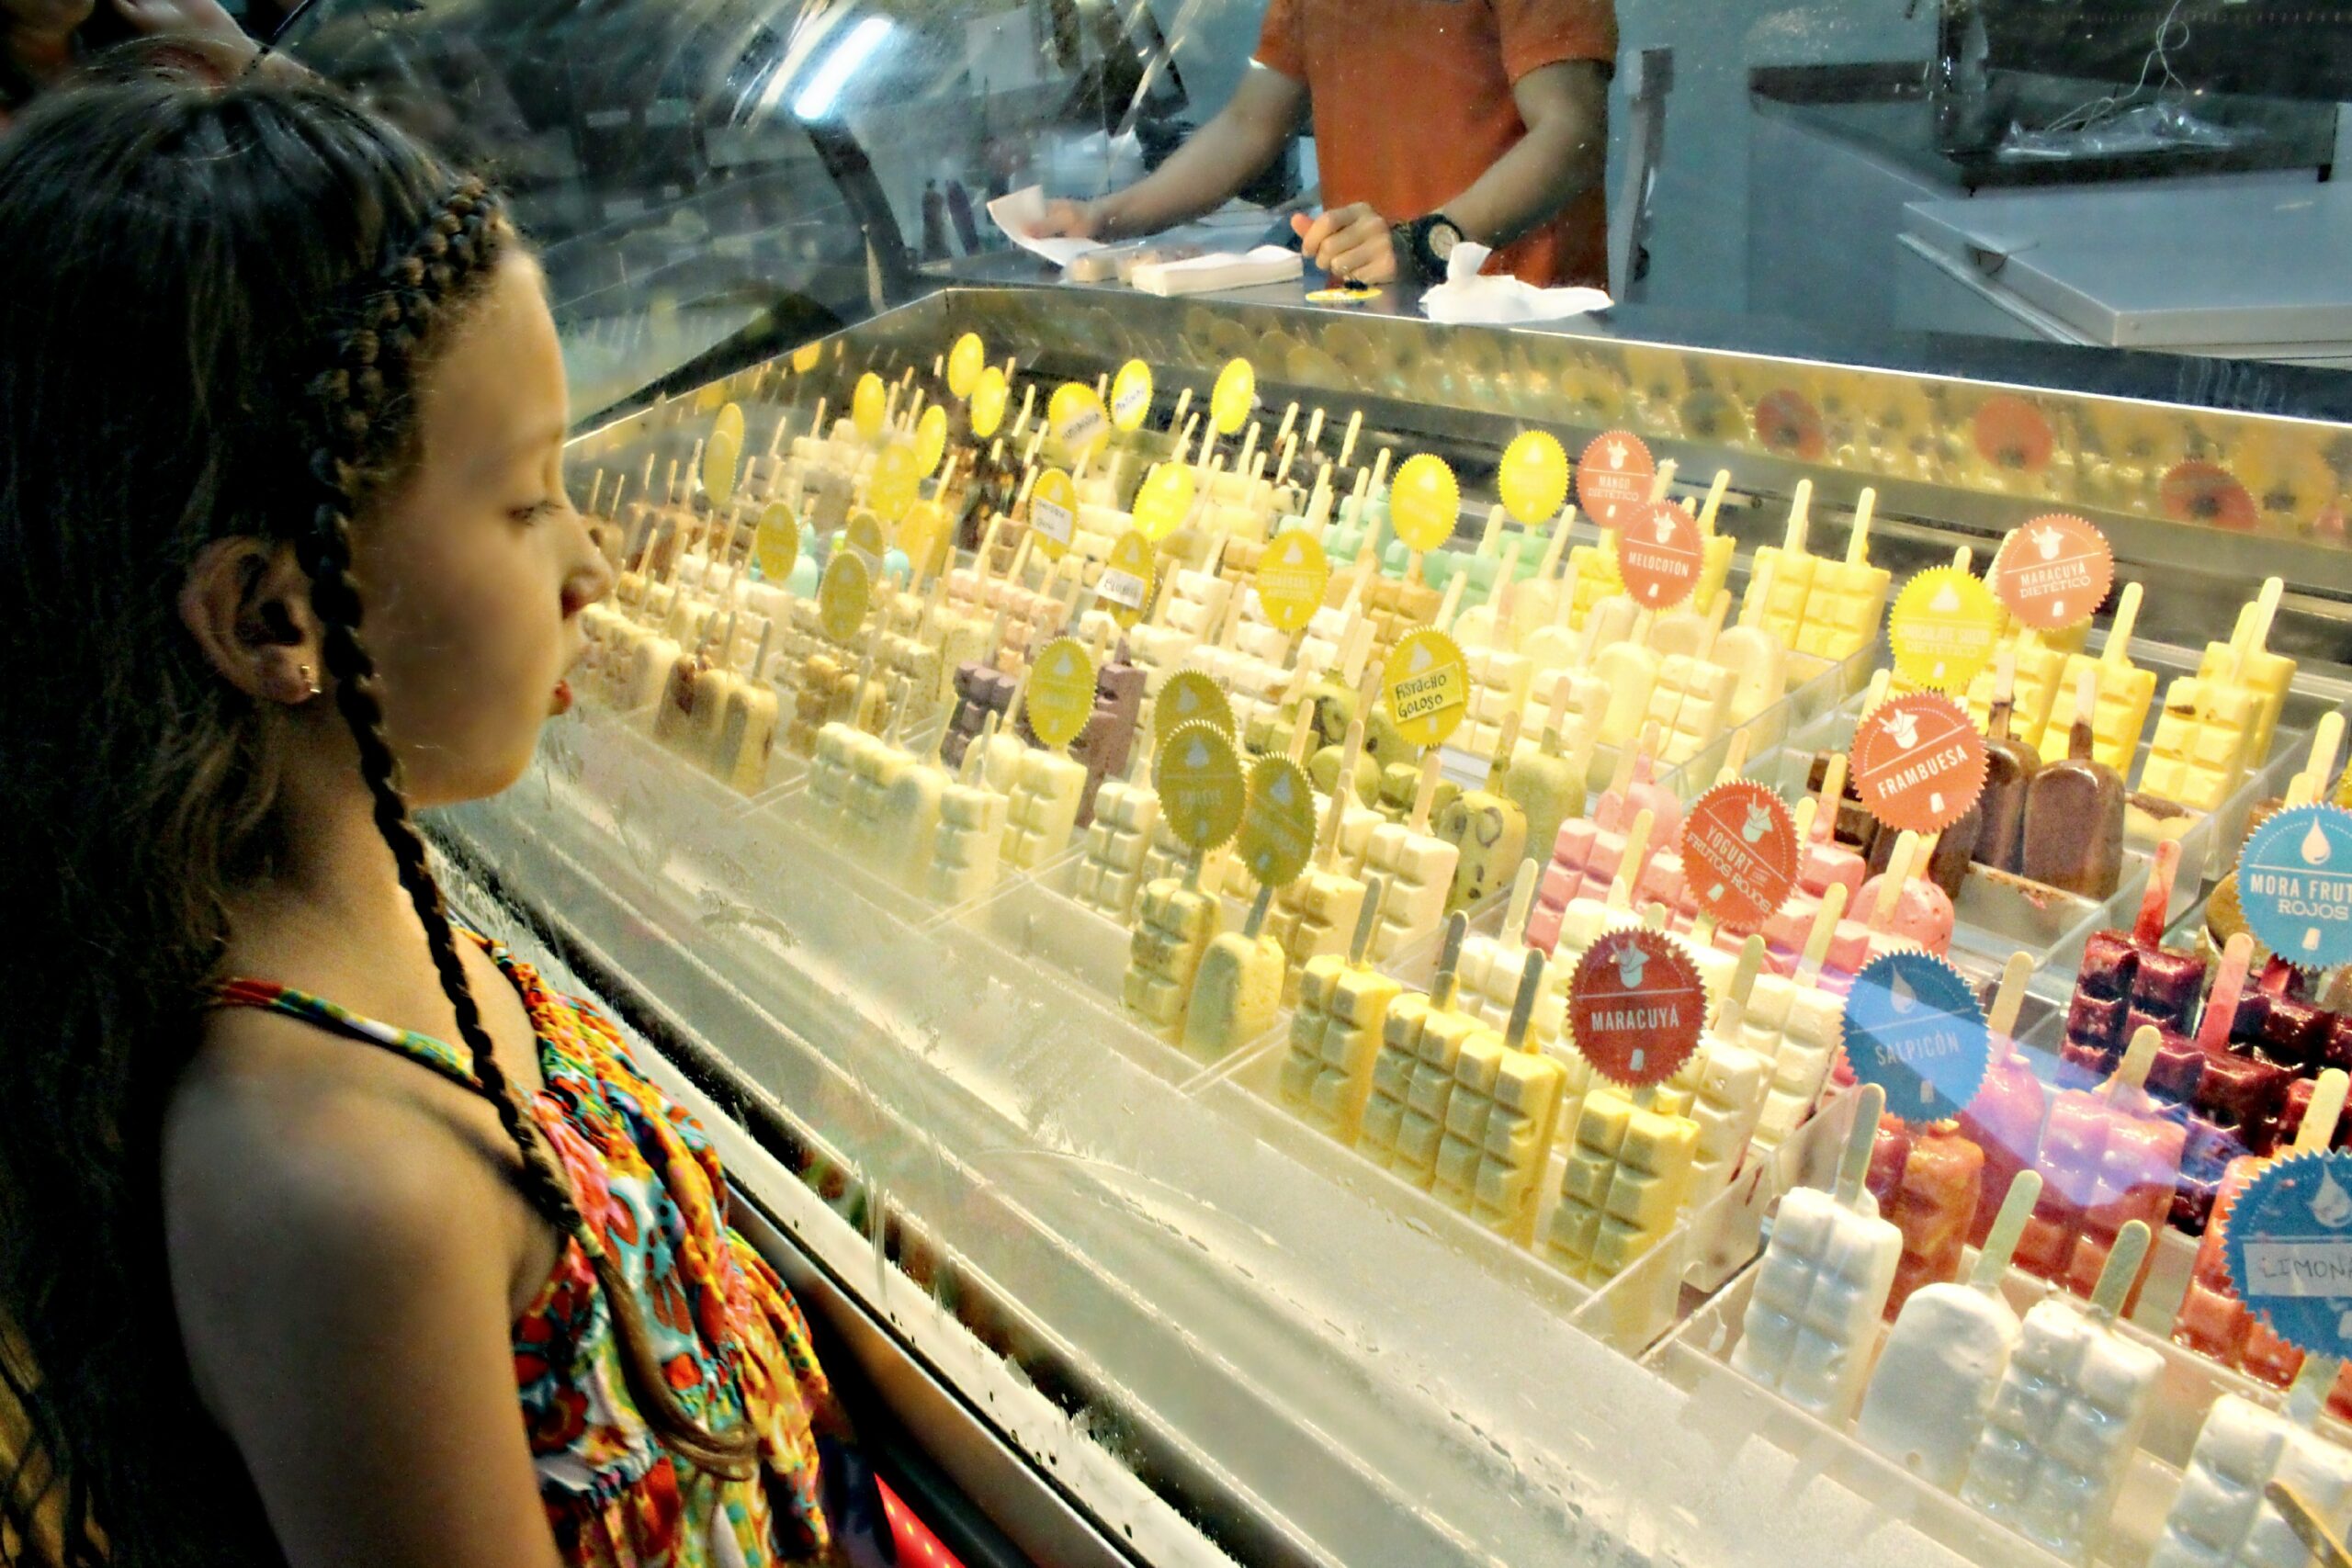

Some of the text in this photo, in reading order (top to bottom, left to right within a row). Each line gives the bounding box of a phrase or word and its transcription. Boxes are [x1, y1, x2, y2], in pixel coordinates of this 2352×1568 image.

[1599, 475, 1631, 490] MANGO
[1397, 694, 1443, 718] GOLOSO
[1877, 744, 1969, 799] FRAMBUESA
[1705, 825, 1754, 873] YOGURT
[1687, 831, 1771, 912] FRUTOS ROJOS
[2251, 874, 2300, 897] MORA
[2278, 898, 2349, 919] ROJOS
[1591, 1004, 1679, 1032] MARACUYÁ
[1874, 1029, 1960, 1066] SALPICÓN
